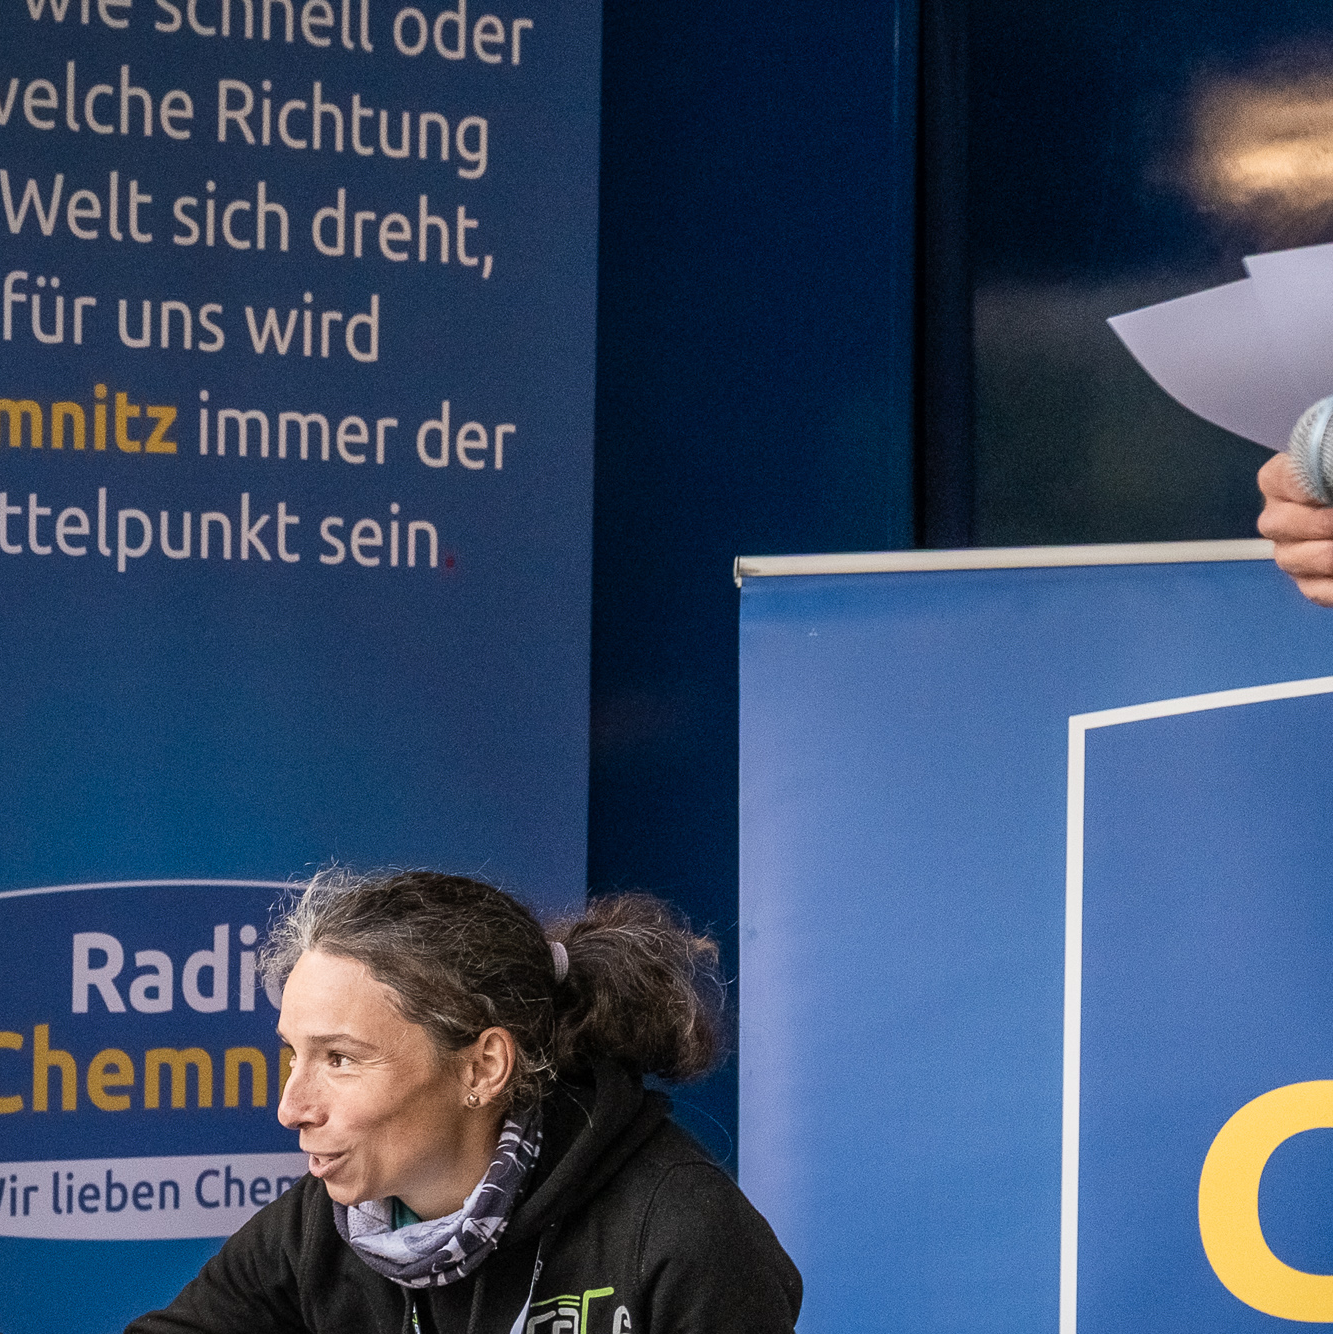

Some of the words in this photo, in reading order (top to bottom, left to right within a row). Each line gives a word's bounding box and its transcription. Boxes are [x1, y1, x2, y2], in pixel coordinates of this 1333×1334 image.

[394, 0, 533, 64] oder
[218, 80, 488, 179] Richtung
[0, 170, 152, 242] Welt
[174, 182, 288, 251] sich
[312, 188, 493, 278] dreht,
[4, 271, 96, 344] für
[119, 300, 224, 352] uns
[245, 293, 379, 362] wird
[200, 390, 398, 464] immer
[417, 401, 516, 469] der
[53, 1170, 180, 1214] lieben
